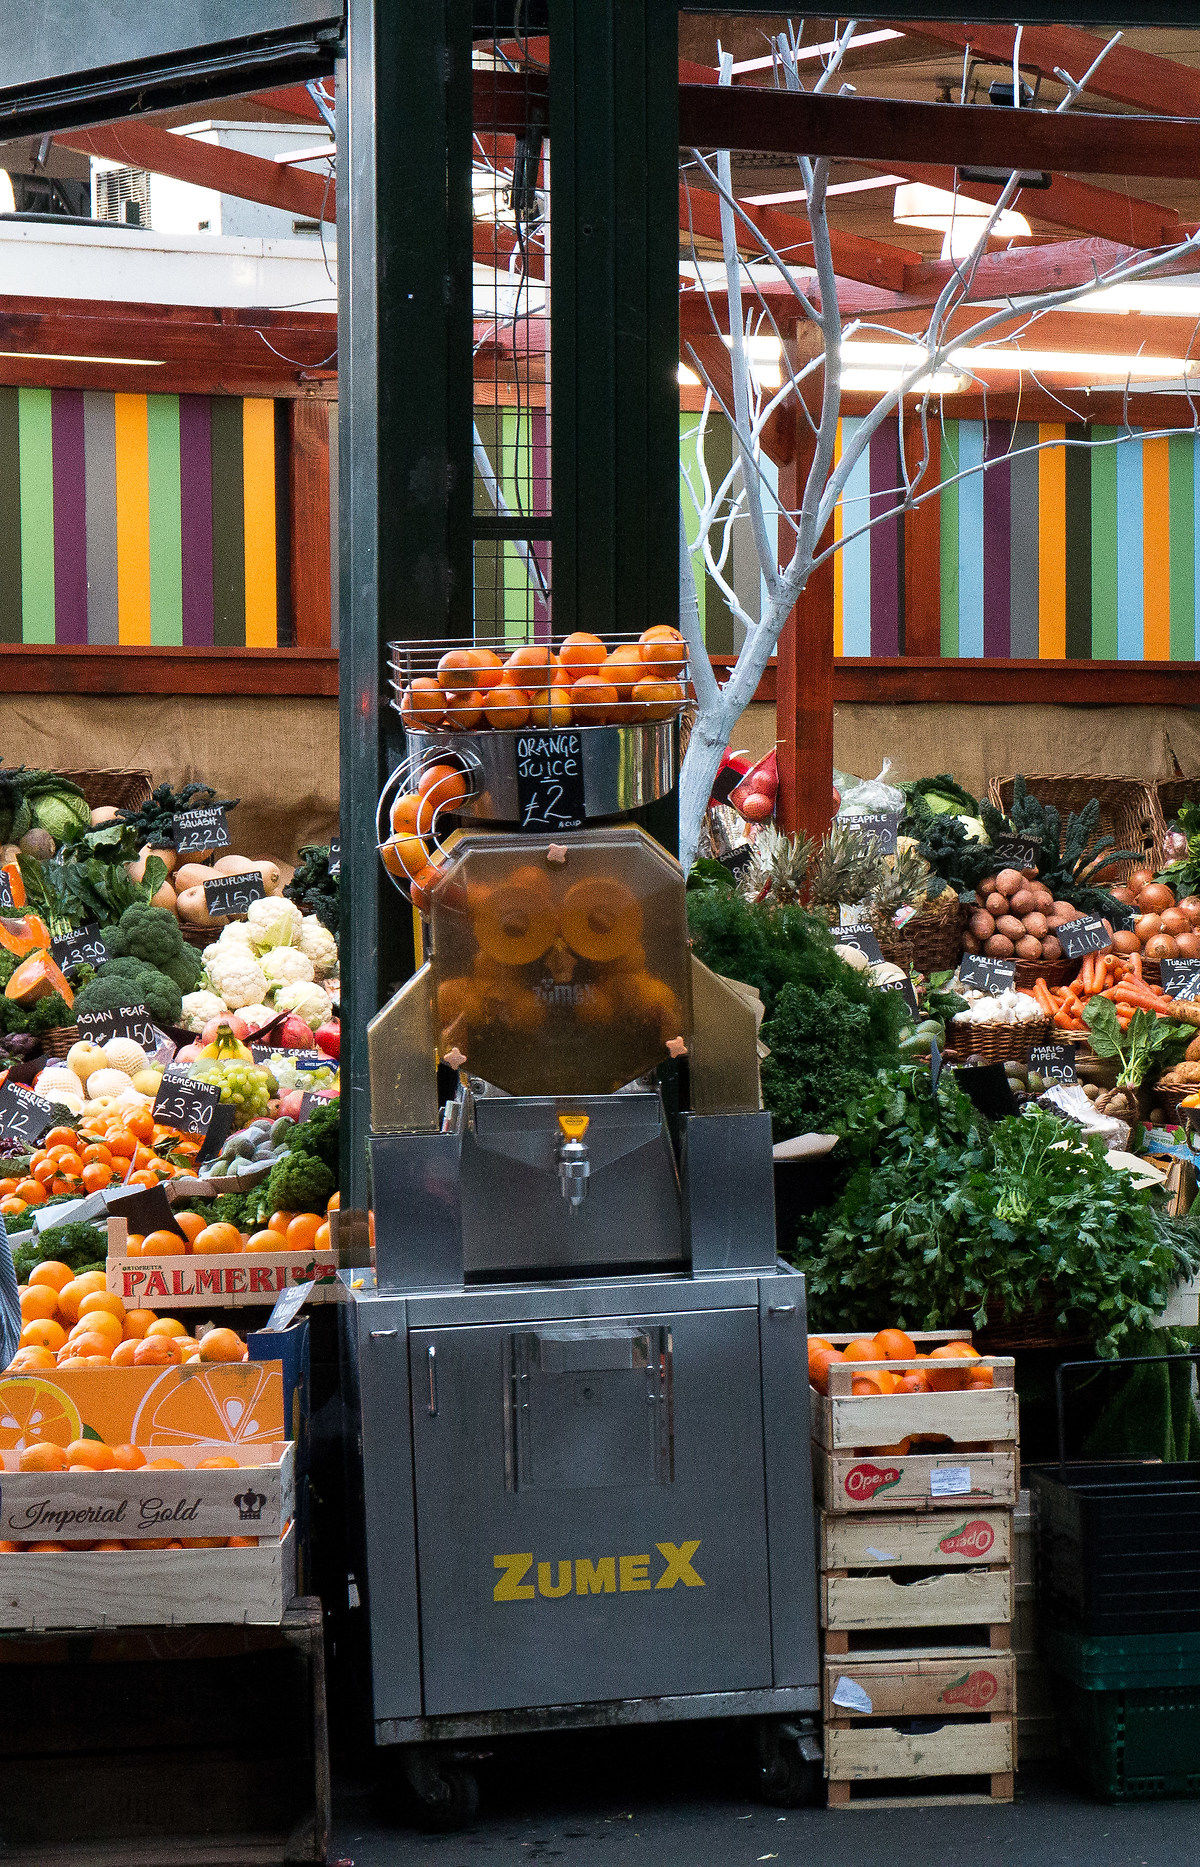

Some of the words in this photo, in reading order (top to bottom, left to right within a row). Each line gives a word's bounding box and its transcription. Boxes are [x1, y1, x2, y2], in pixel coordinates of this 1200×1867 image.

[518, 735, 580, 757] ORANGE
[518, 758, 579, 777] JUICE
[173, 806, 224, 822] BUTTERNUT
[522, 785, 572, 827] £2
[203, 872, 263, 889] CAULIFLOWER
[1058, 916, 1094, 933] CARROTS
[76, 1009, 113, 1025] ASIAN
[252, 1044, 284, 1055] WHITE
[1033, 1045, 1065, 1054] MARIS
[168, 1062, 193, 1072] BAN
[162, 1073, 216, 1096] CLEMENTINE
[153, 1097, 213, 1126] £3.30
[121, 1264, 287, 1298] PALMERI
[8, 1500, 129, 1533] Imperial
[137, 1498, 204, 1530] Gold
